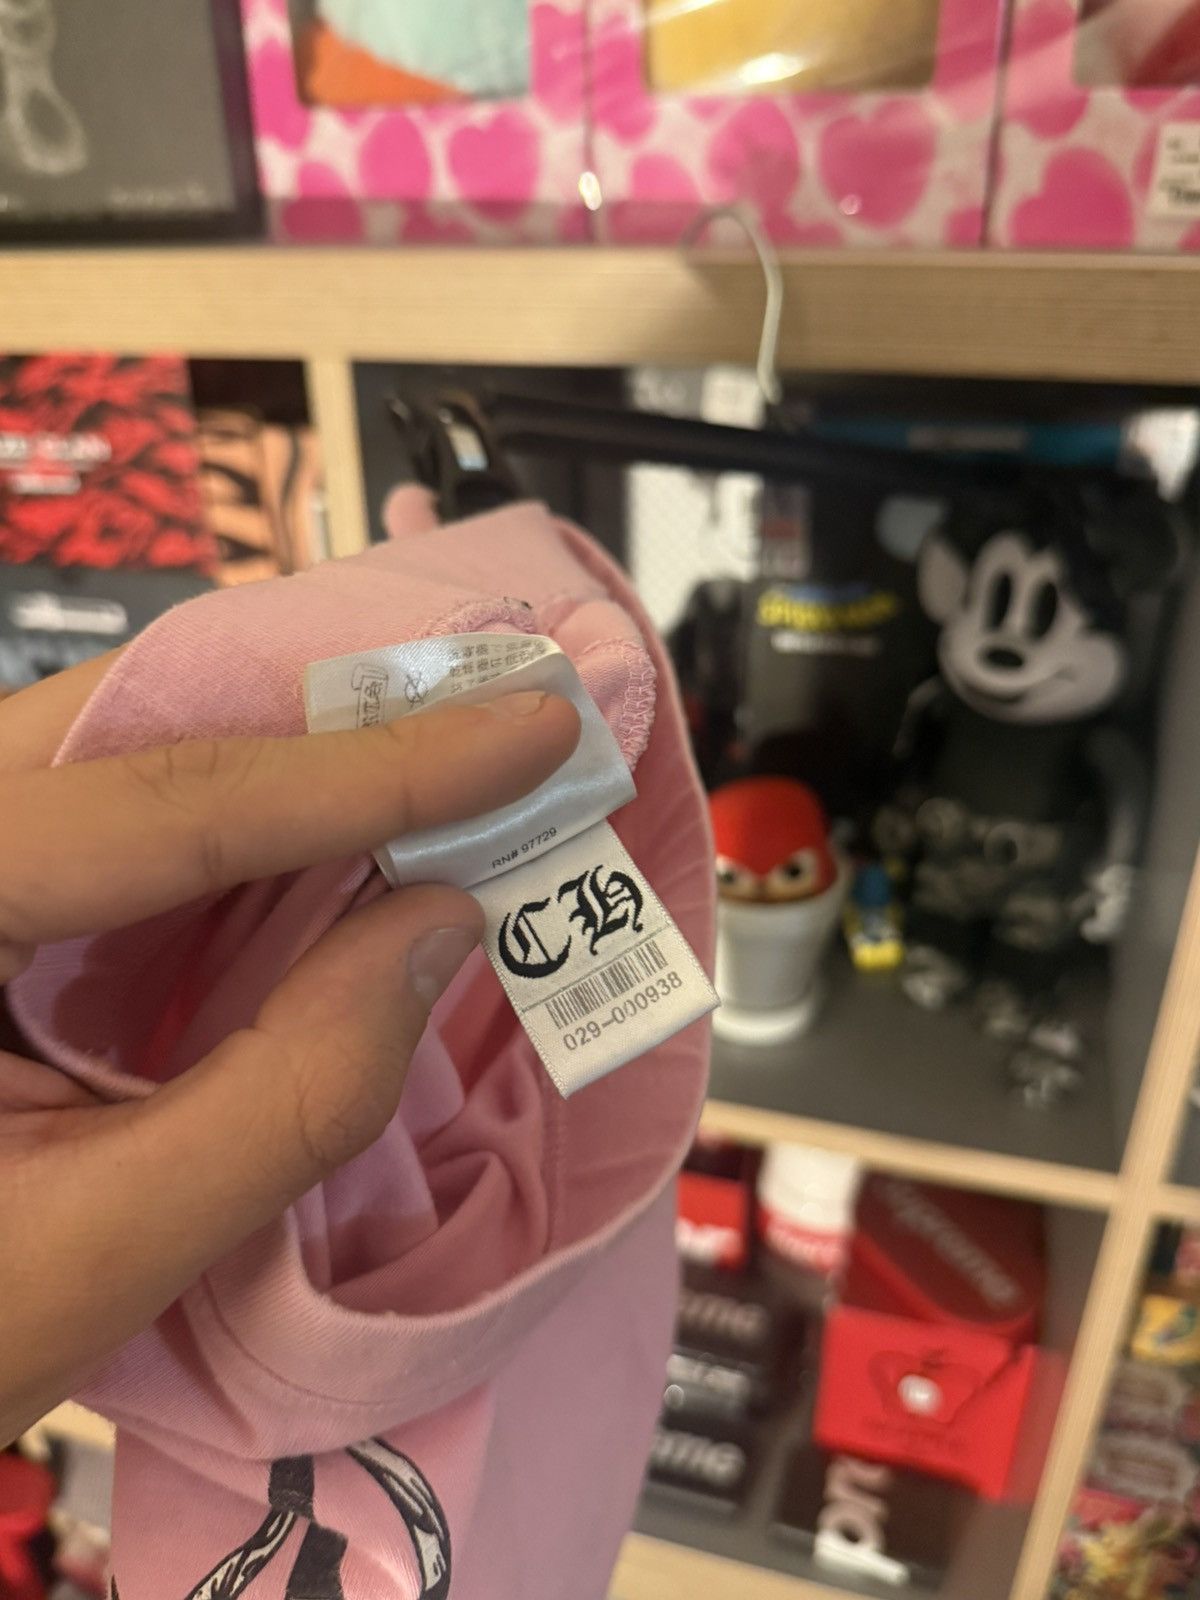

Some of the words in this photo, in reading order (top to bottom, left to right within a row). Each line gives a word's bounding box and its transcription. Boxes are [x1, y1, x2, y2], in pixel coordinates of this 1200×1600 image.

[492, 849, 518, 869] RN#
[521, 827, 557, 853] 97729
[562, 971, 684, 1051] 029-000938
